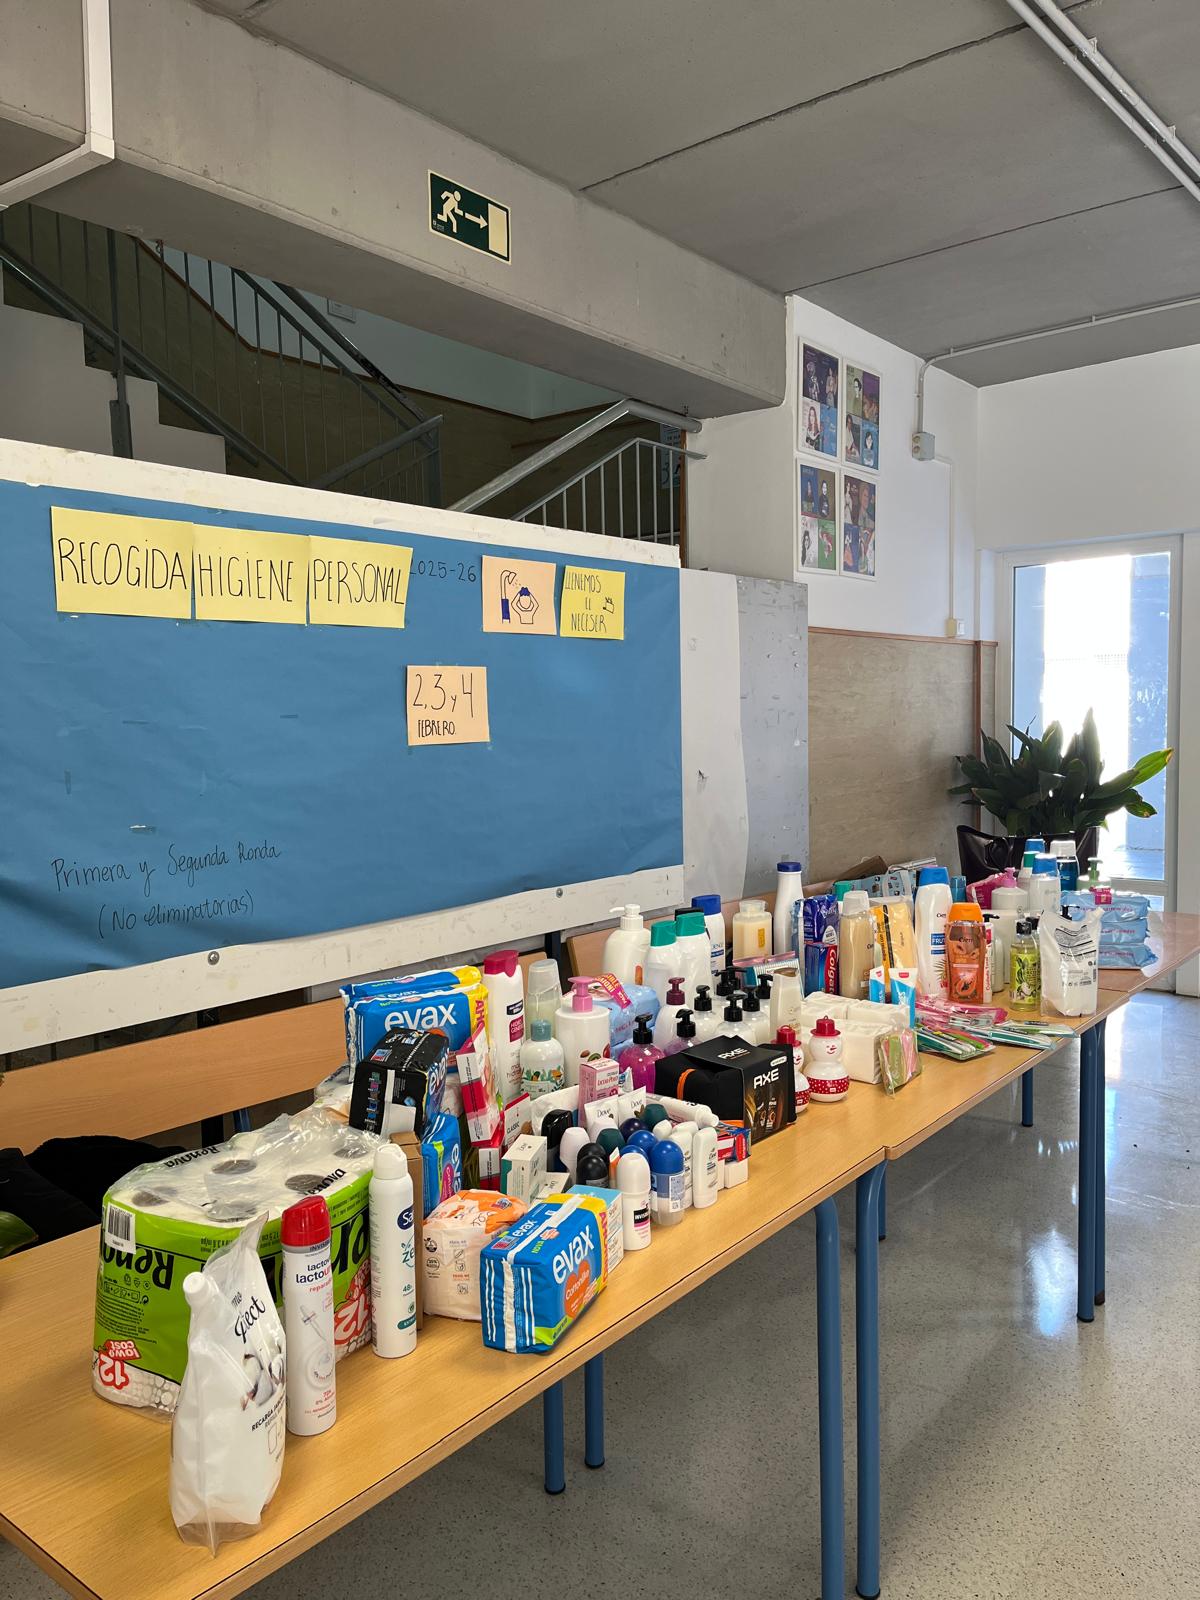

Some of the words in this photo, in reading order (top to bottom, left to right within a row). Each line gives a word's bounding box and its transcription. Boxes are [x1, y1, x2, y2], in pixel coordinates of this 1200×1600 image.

[57, 536, 188, 591] RECOGIDA
[198, 549, 294, 603] HIGIENE
[312, 558, 406, 606] PERSONAL
[570, 611, 608, 634] NECESER
[50, 857, 132, 893] Primera
[138, 860, 157, 899] y
[167, 842, 230, 889] Segunda
[237, 839, 283, 865] Ronda
[384, 1003, 458, 1034] evax
[717, 1047, 749, 1060] AXE
[753, 1068, 780, 1089] AXE
[596, 1108, 611, 1119] Dove
[163, 1144, 221, 1169] Renova
[552, 1224, 595, 1285] evax
[110, 1340, 135, 1351] cost
[99, 1352, 127, 1387] 12
